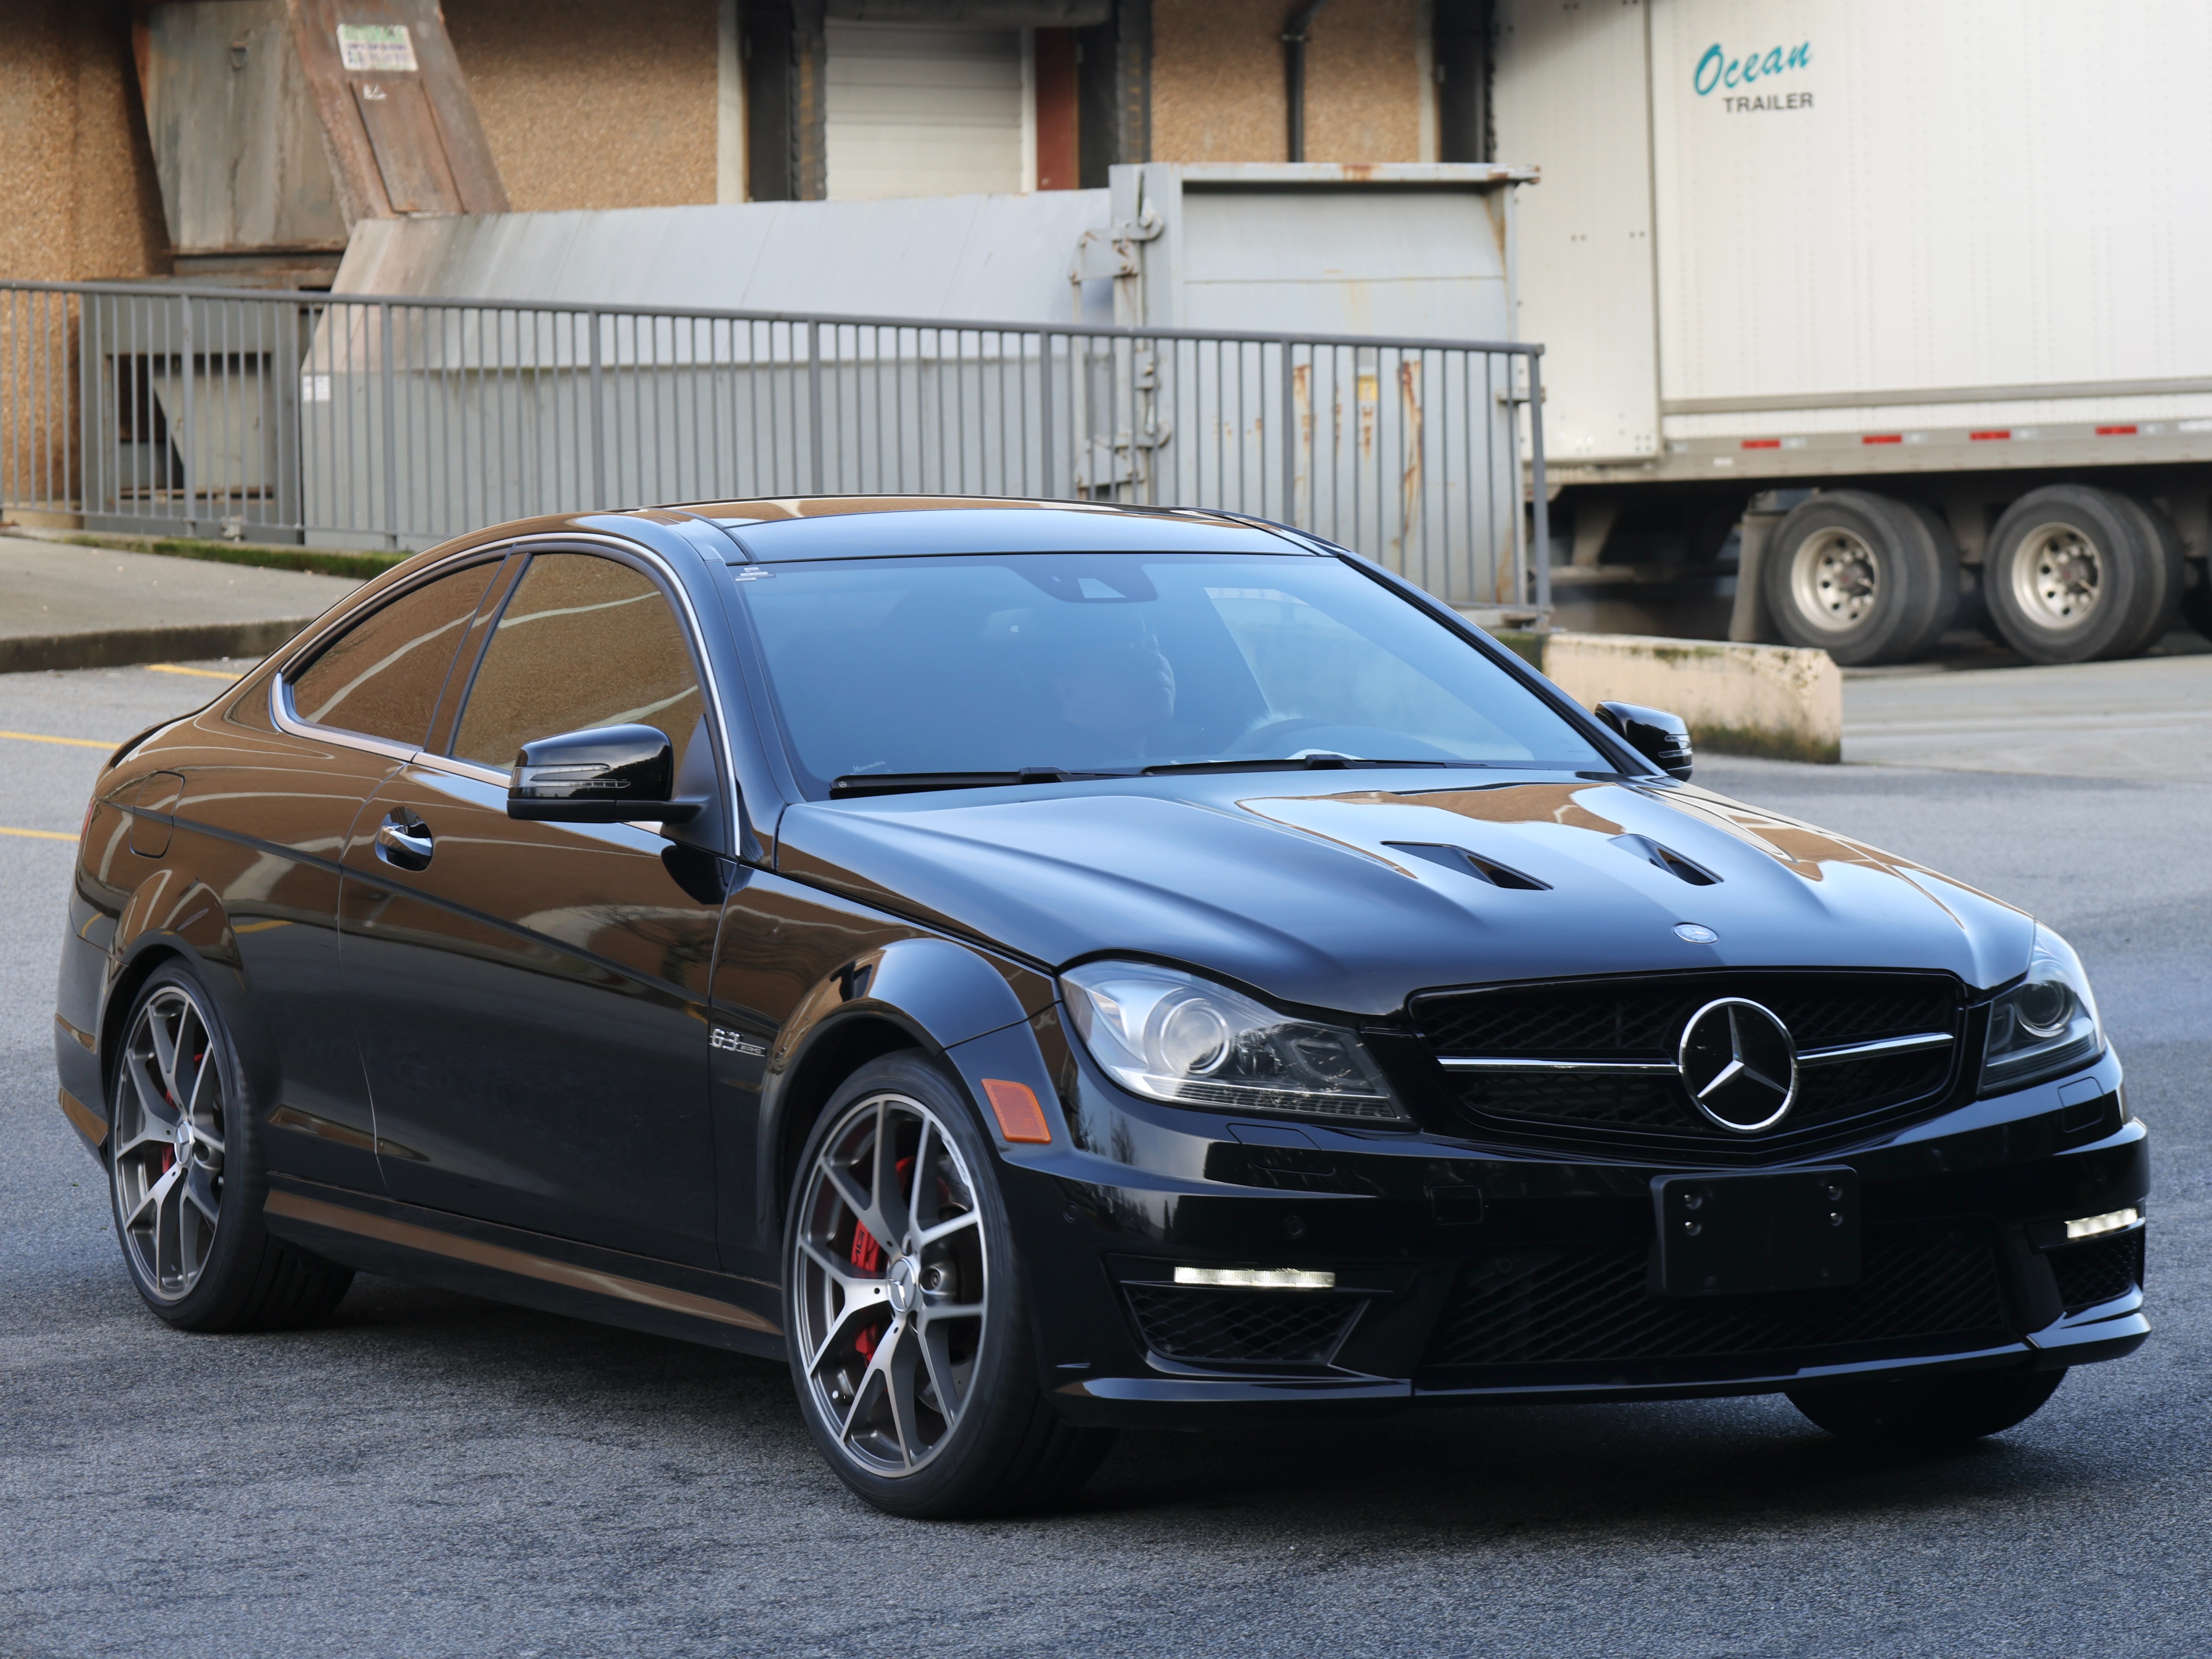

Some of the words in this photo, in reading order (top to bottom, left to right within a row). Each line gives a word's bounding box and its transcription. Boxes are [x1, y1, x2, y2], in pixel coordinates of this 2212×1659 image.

[1694, 40, 1812, 96] Ocean
[1723, 92, 1814, 113] TRAILER
[711, 1028, 740, 1051] 63
